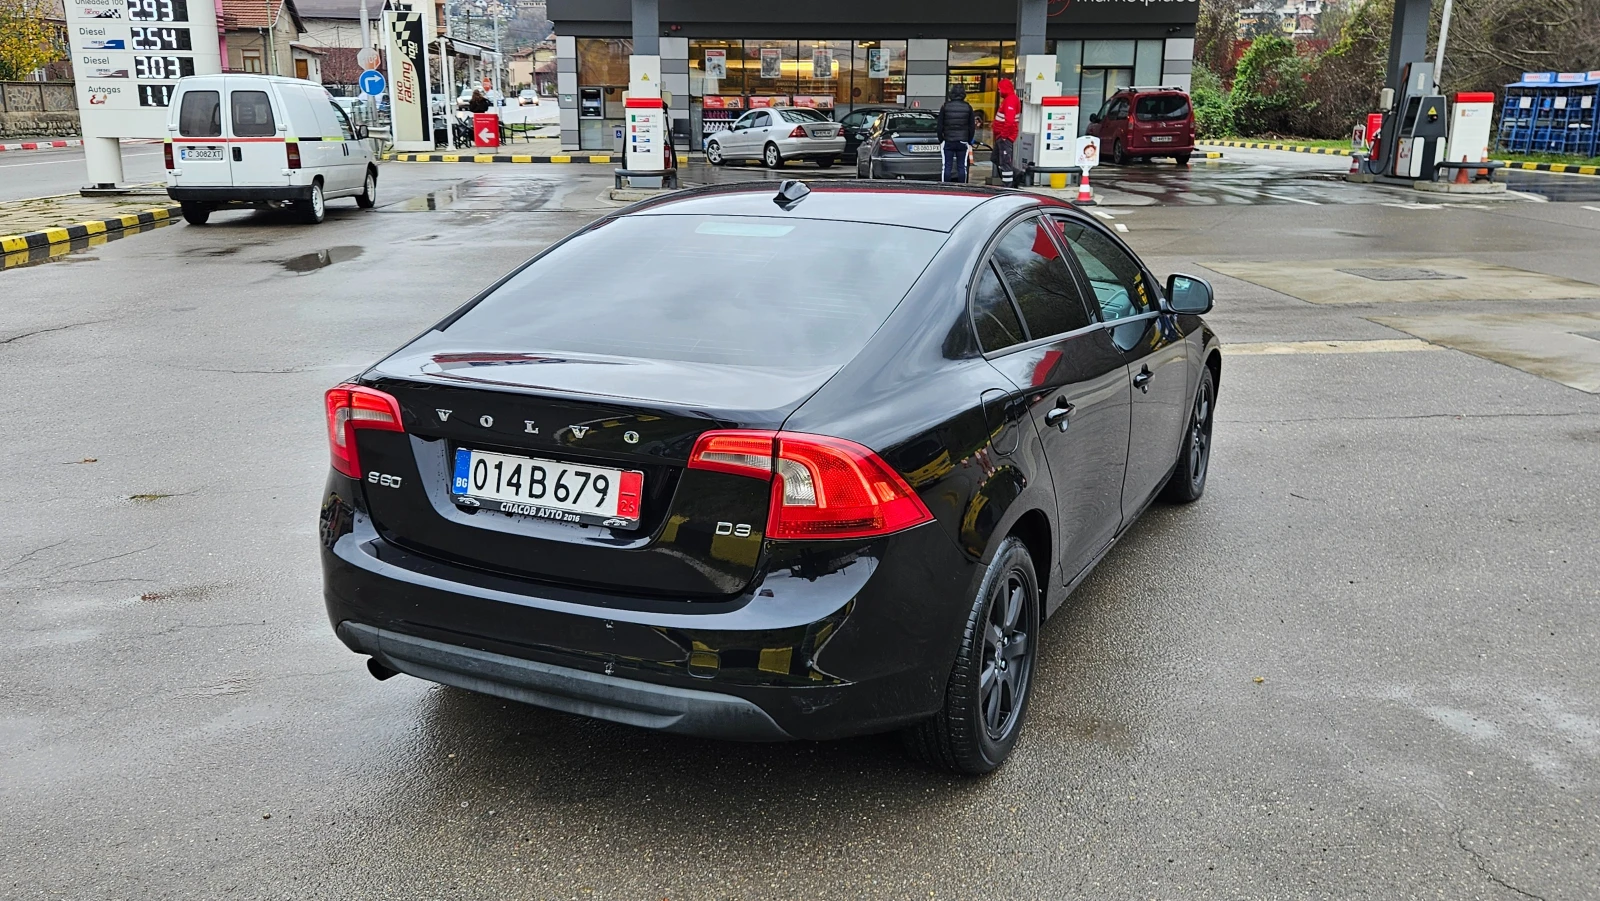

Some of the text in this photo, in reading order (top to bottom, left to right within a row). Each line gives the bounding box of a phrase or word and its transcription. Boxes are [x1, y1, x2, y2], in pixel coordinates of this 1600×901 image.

[128, 0, 175, 21] 2.93
[79, 27, 106, 36] Diesel
[132, 27, 178, 50] 2.54
[408, 41, 416, 59] 100
[83, 56, 110, 65] Diesel
[136, 56, 181, 79] 3.03
[87, 86, 121, 95] Autogas
[402, 61, 413, 103] racing
[195, 150, 212, 158] 3082
[436, 408, 640, 444] VOLVO
[368, 471, 402, 489] S60
[455, 477, 468, 488] BG
[500, 502, 581, 523] СПАСОВ АУТО 2016
[620, 499, 635, 513] 26
[715, 521, 752, 537] D3
